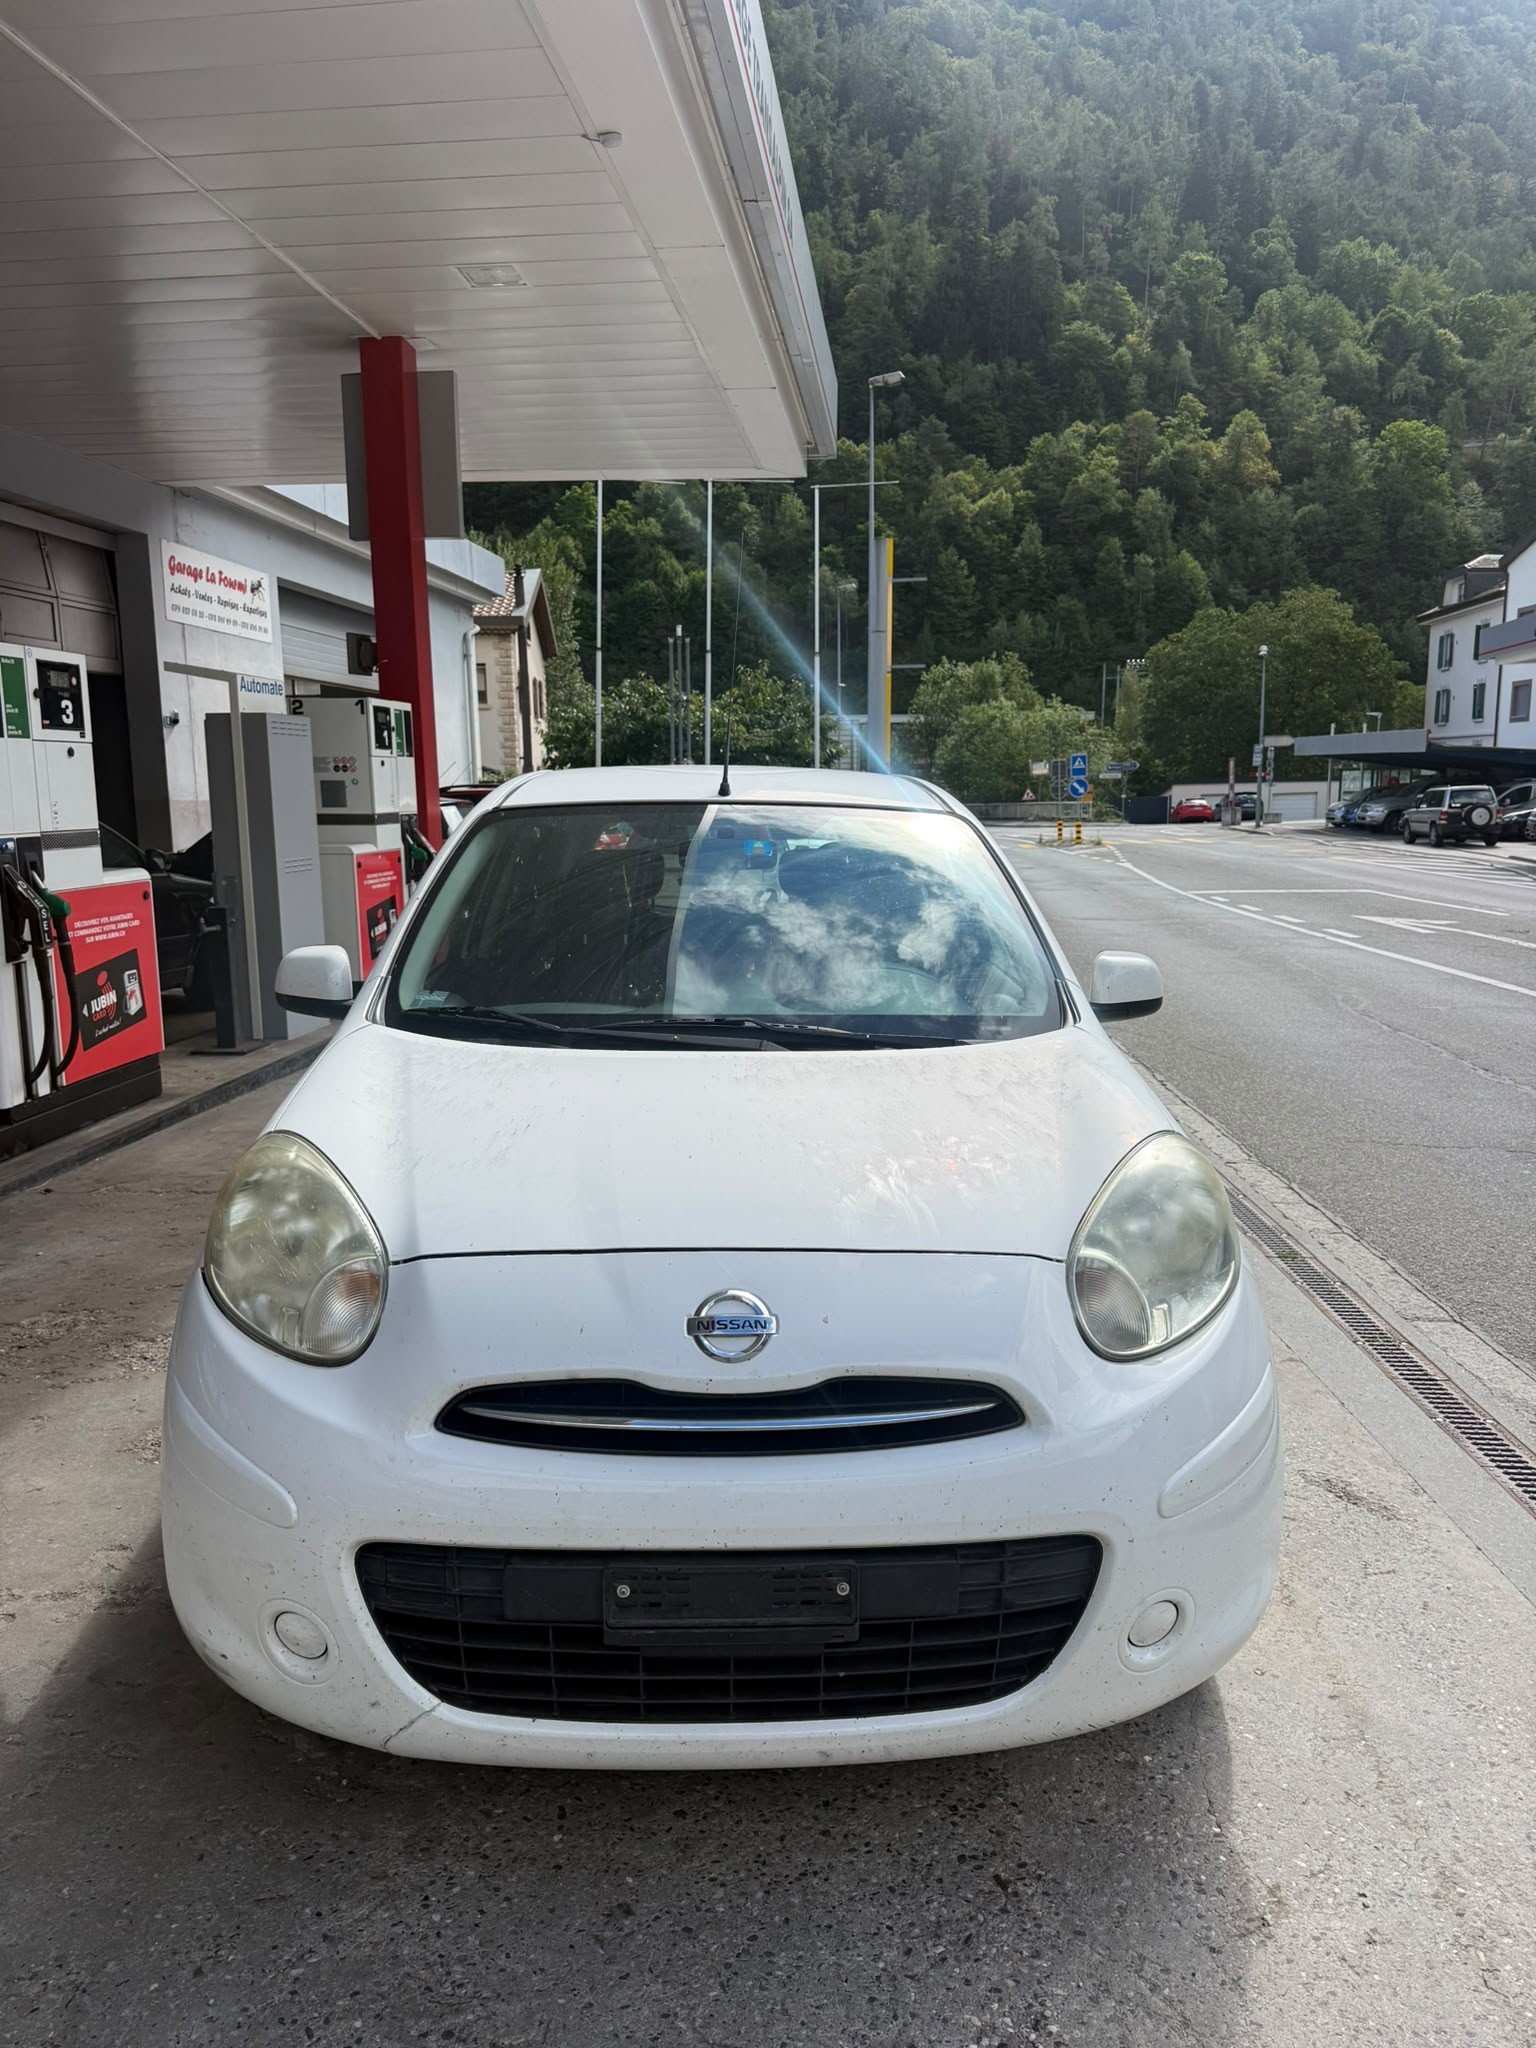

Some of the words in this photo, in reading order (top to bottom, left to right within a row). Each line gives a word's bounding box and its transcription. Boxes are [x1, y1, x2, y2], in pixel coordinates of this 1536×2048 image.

[168, 554, 203, 583] Garage
[206, 566, 216, 584] La
[218, 569, 247, 594] Fourmi
[170, 582, 191, 598] Achats
[195, 589, 213, 604] Ventes
[217, 595, 239, 612] Reprises
[243, 603, 267, 619] Expertises
[240, 677, 283, 696] Automate
[61, 699, 74, 725] 3
[292, 700, 304, 715] 2
[355, 699, 365, 715] 1
[382, 729, 389, 747] 1
[17, 880, 51, 943] DIESEL
[91, 989, 117, 1014] JUBIN
[93, 1010, 107, 1022] CARD
[697, 1319, 767, 1331] NISSAN
